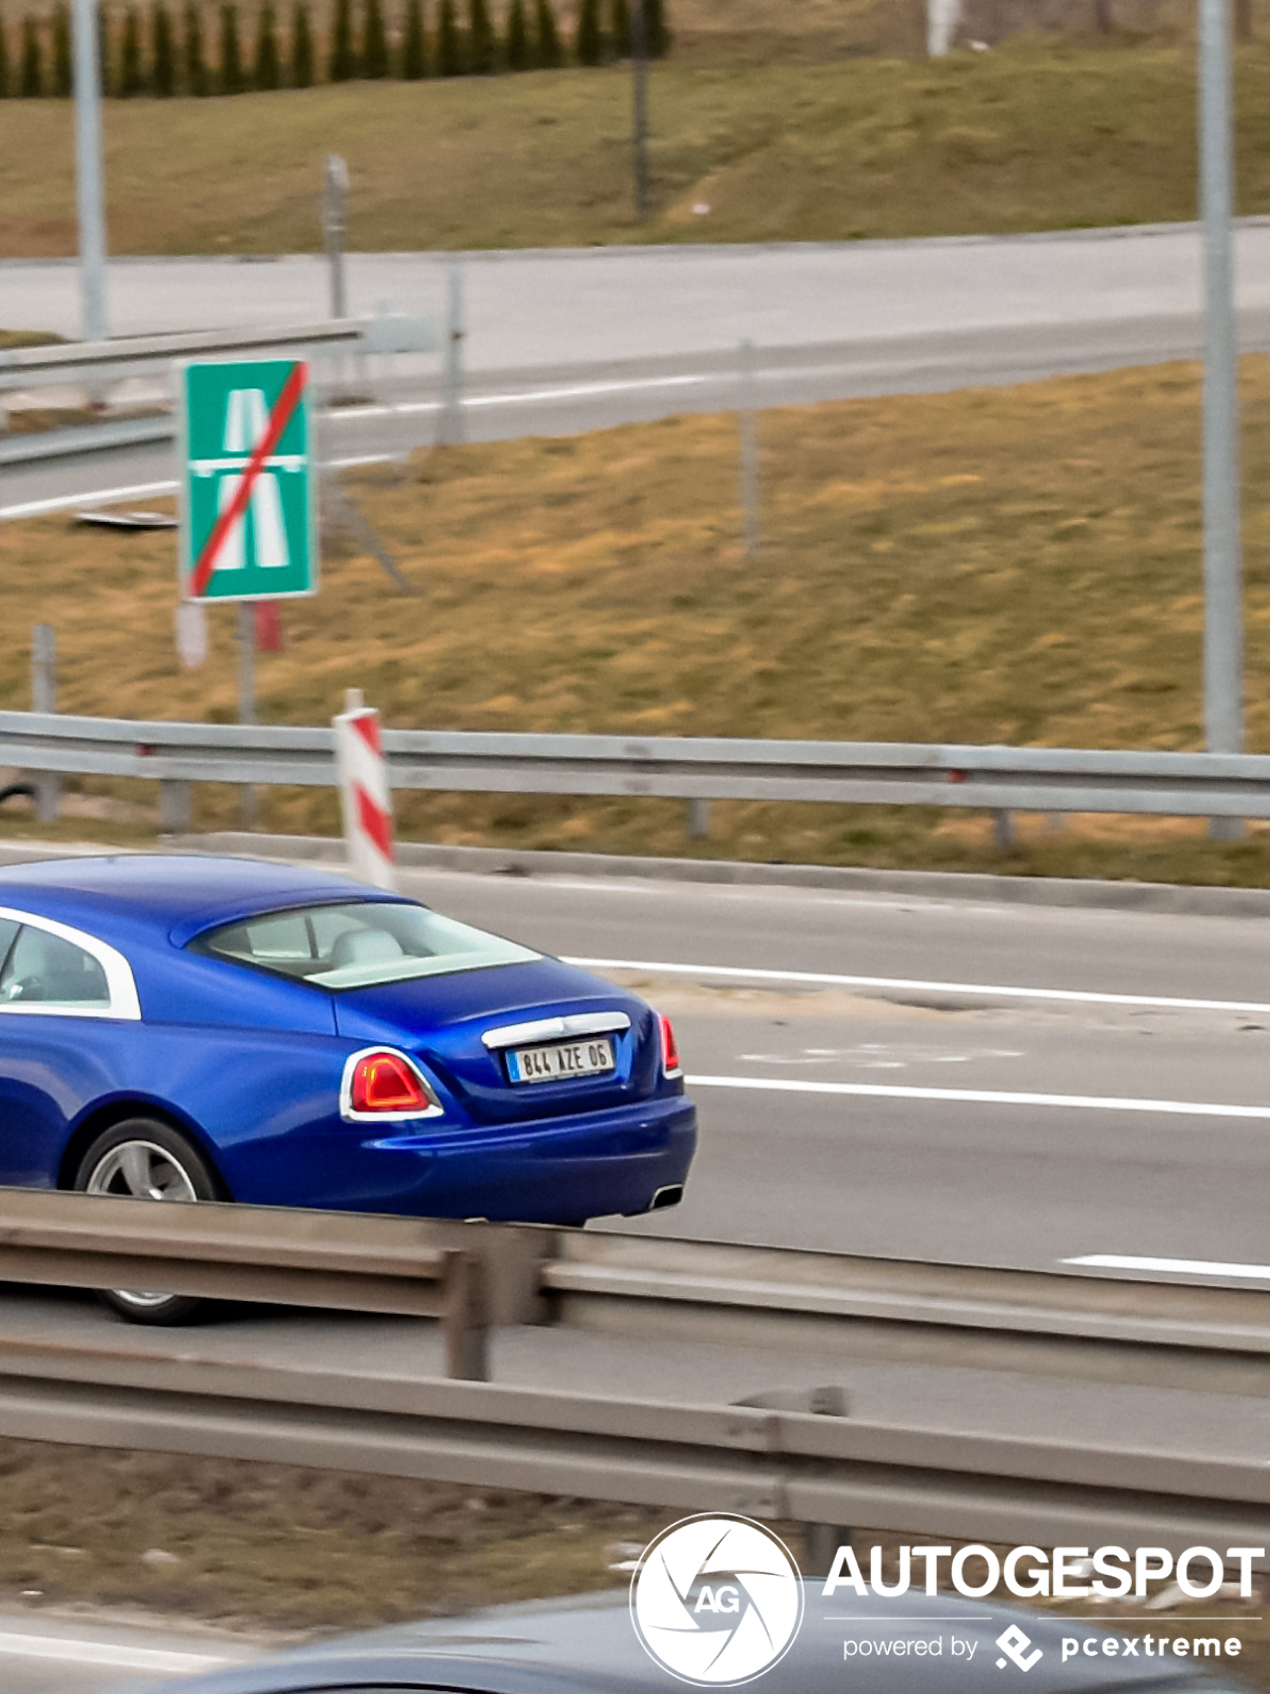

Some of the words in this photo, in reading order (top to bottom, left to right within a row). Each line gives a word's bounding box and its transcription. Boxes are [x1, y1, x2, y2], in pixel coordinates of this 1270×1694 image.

[523, 1052, 551, 1076] 844
[557, 1047, 584, 1071] AZE
[588, 1044, 607, 1066] 06
